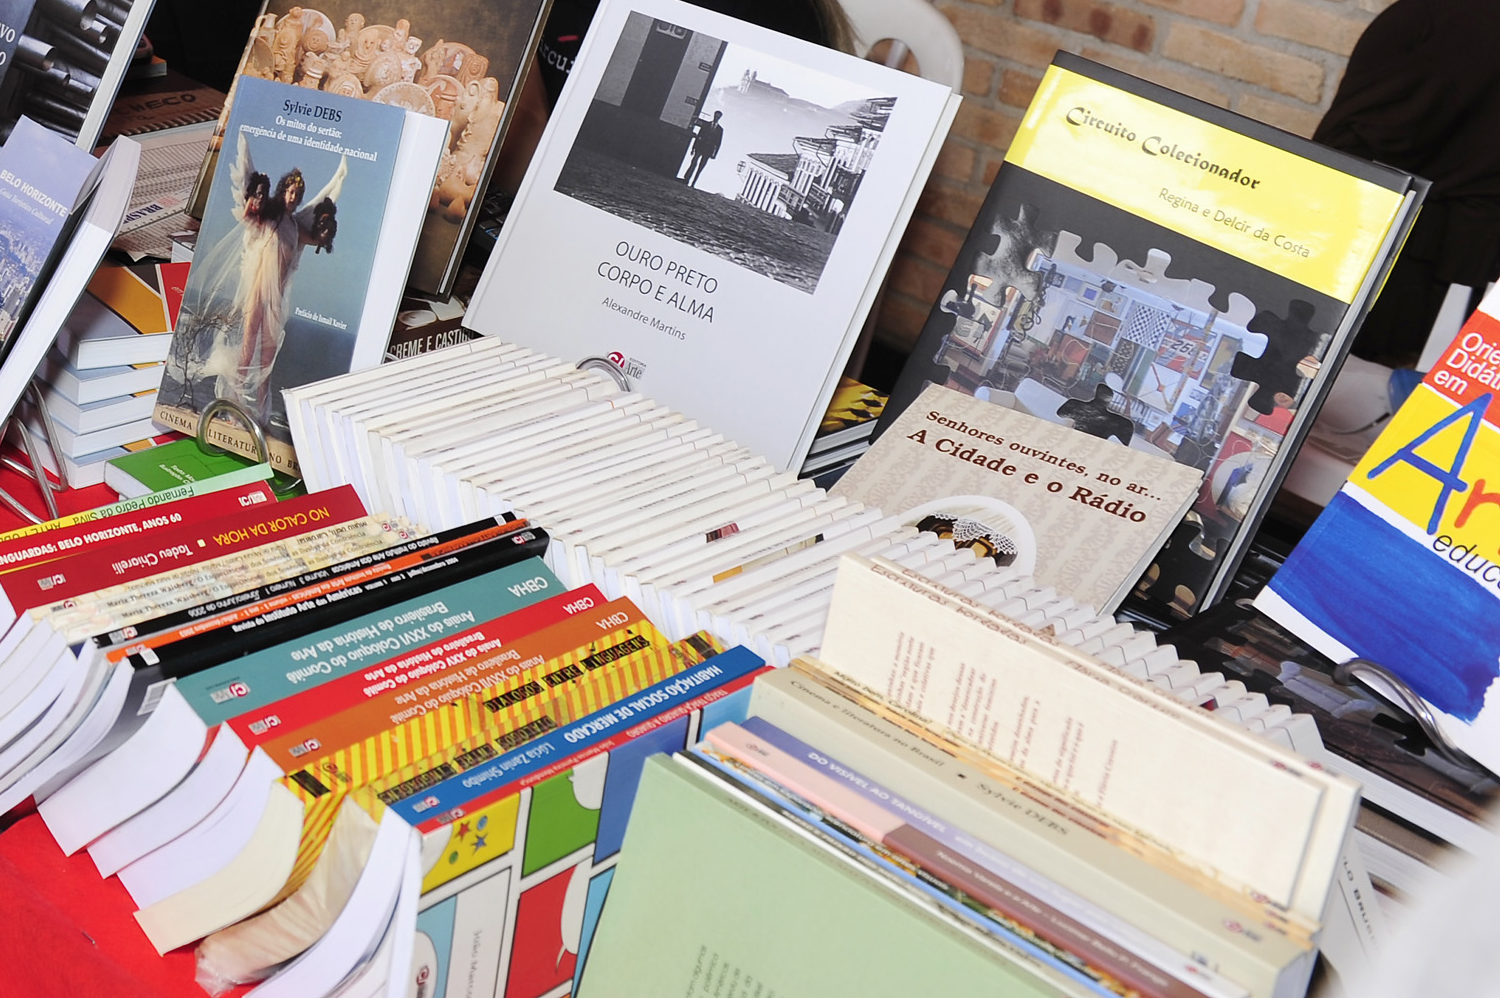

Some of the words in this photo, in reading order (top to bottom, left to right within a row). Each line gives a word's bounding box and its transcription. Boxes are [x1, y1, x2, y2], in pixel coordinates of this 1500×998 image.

[283, 99, 312, 121] Sylvie
[313, 104, 343, 123] DEBS
[275, 116, 286, 128] Os
[286, 118, 306, 132] mitos
[307, 122, 318, 134] do
[319, 124, 342, 139] sertão:
[240, 123, 276, 141] emergência
[278, 129, 287, 140] de
[287, 133, 303, 144] uma
[303, 134, 344, 155] identidade
[344, 145, 377, 162] nacional
[1065, 106, 1137, 143] Circuito
[1141, 135, 1261, 192] Colecionador
[0, 169, 23, 191] BELO
[20, 180, 68, 217] HORIZONTE
[1158, 186, 1200, 215] Regina
[1202, 205, 1211, 218] e
[1213, 208, 1252, 235] Delcir
[1254, 226, 1270, 243] da
[1273, 233, 1311, 259] Costa
[615, 240, 664, 272] OURO
[665, 259, 719, 295] PRETO
[597, 261, 654, 296] CORPO
[654, 286, 665, 302] E
[666, 290, 715, 323] ALMA
[601, 296, 649, 325] Alexandre
[649, 316, 687, 341] Martins
[1433, 368, 1468, 396] em
[160, 411, 193, 430] CINEMA
[925, 410, 1005, 448] Senhores
[1009, 439, 1090, 479] ouvintes,
[1095, 470, 1122, 487] no
[1126, 479, 1162, 502] ar...
[1367, 393, 1500, 536] Ar
[907, 428, 928, 445] A
[934, 437, 1018, 477] Cidade
[1023, 470, 1040, 484] e
[1047, 479, 1063, 493] o
[1068, 485, 1148, 524] Rádio
[113, 497, 147, 516] Pedro
[147, 484, 194, 506] Fernando
[71, 510, 97, 526] Silva
[96, 506, 113, 520] da
[266, 509, 308, 533] CALOR
[307, 504, 329, 521] NO
[57, 535, 83, 551] BELO
[83, 520, 142, 546] HORIZONTE,
[141, 513, 169, 530] ANOS
[168, 510, 182, 523] 60
[212, 526, 248, 547] HORA
[247, 521, 267, 538] DA
[110, 550, 159, 576] Chiarelli
[157, 541, 192, 563] Tadeu
[507, 573, 549, 599] CBHA
[392, 598, 447, 628] Brasileiro
[562, 595, 594, 616] CBHA
[377, 617, 393, 633] de
[426, 618, 444, 635] do
[443, 608, 475, 630] Anais
[594, 608, 628, 632] CBHA
[317, 638, 334, 654] da
[333, 622, 379, 649] História
[397, 624, 429, 646] XXVI
[445, 630, 485, 652] Brasileiro
[476, 637, 502, 655] Anais
[290, 644, 317, 663] Arte
[344, 633, 398, 664] Colóquio
[397, 649, 433, 670] História
[432, 644, 445, 657] de
[445, 651, 465, 666] XXV
[464, 646, 478, 660] do
[475, 646, 520, 673] Brasileiro
[285, 658, 330, 686] Comitê
[328, 653, 346, 670] do
[384, 662, 398, 675] da
[407, 656, 447, 680] Colóquio
[462, 664, 476, 678] de
[505, 663, 520, 677] do
[518, 653, 545, 672] Anais
[542, 662, 583, 690] ENTRE
[581, 632, 650, 673] LINGUAGENS
[361, 676, 397, 697] Comitê
[363, 667, 385, 683] Arte
[395, 671, 408, 685] do
[429, 668, 466, 693] História
[478, 668, 508, 689] XXVII
[664, 659, 723, 699] HABITAÇÃO
[394, 688, 418, 706] Arte
[416, 683, 430, 697] da
[439, 678, 480, 704] Colóquio
[632, 686, 669, 713] SOCIAL
[791, 680, 831, 705] Cinema
[389, 701, 428, 726] Comitê
[426, 696, 440, 710] do
[615, 702, 636, 721] DE
[562, 709, 618, 746] MERCADO
[526, 738, 555, 762] Lúcia
[497, 751, 530, 776] Zanin
[461, 764, 501, 792] Shimbo
[807, 750, 828, 767] DO
[827, 761, 870, 791] VISÍVEL
[868, 784, 890, 802] AO
[889, 795, 948, 835] TANGÍVEL
